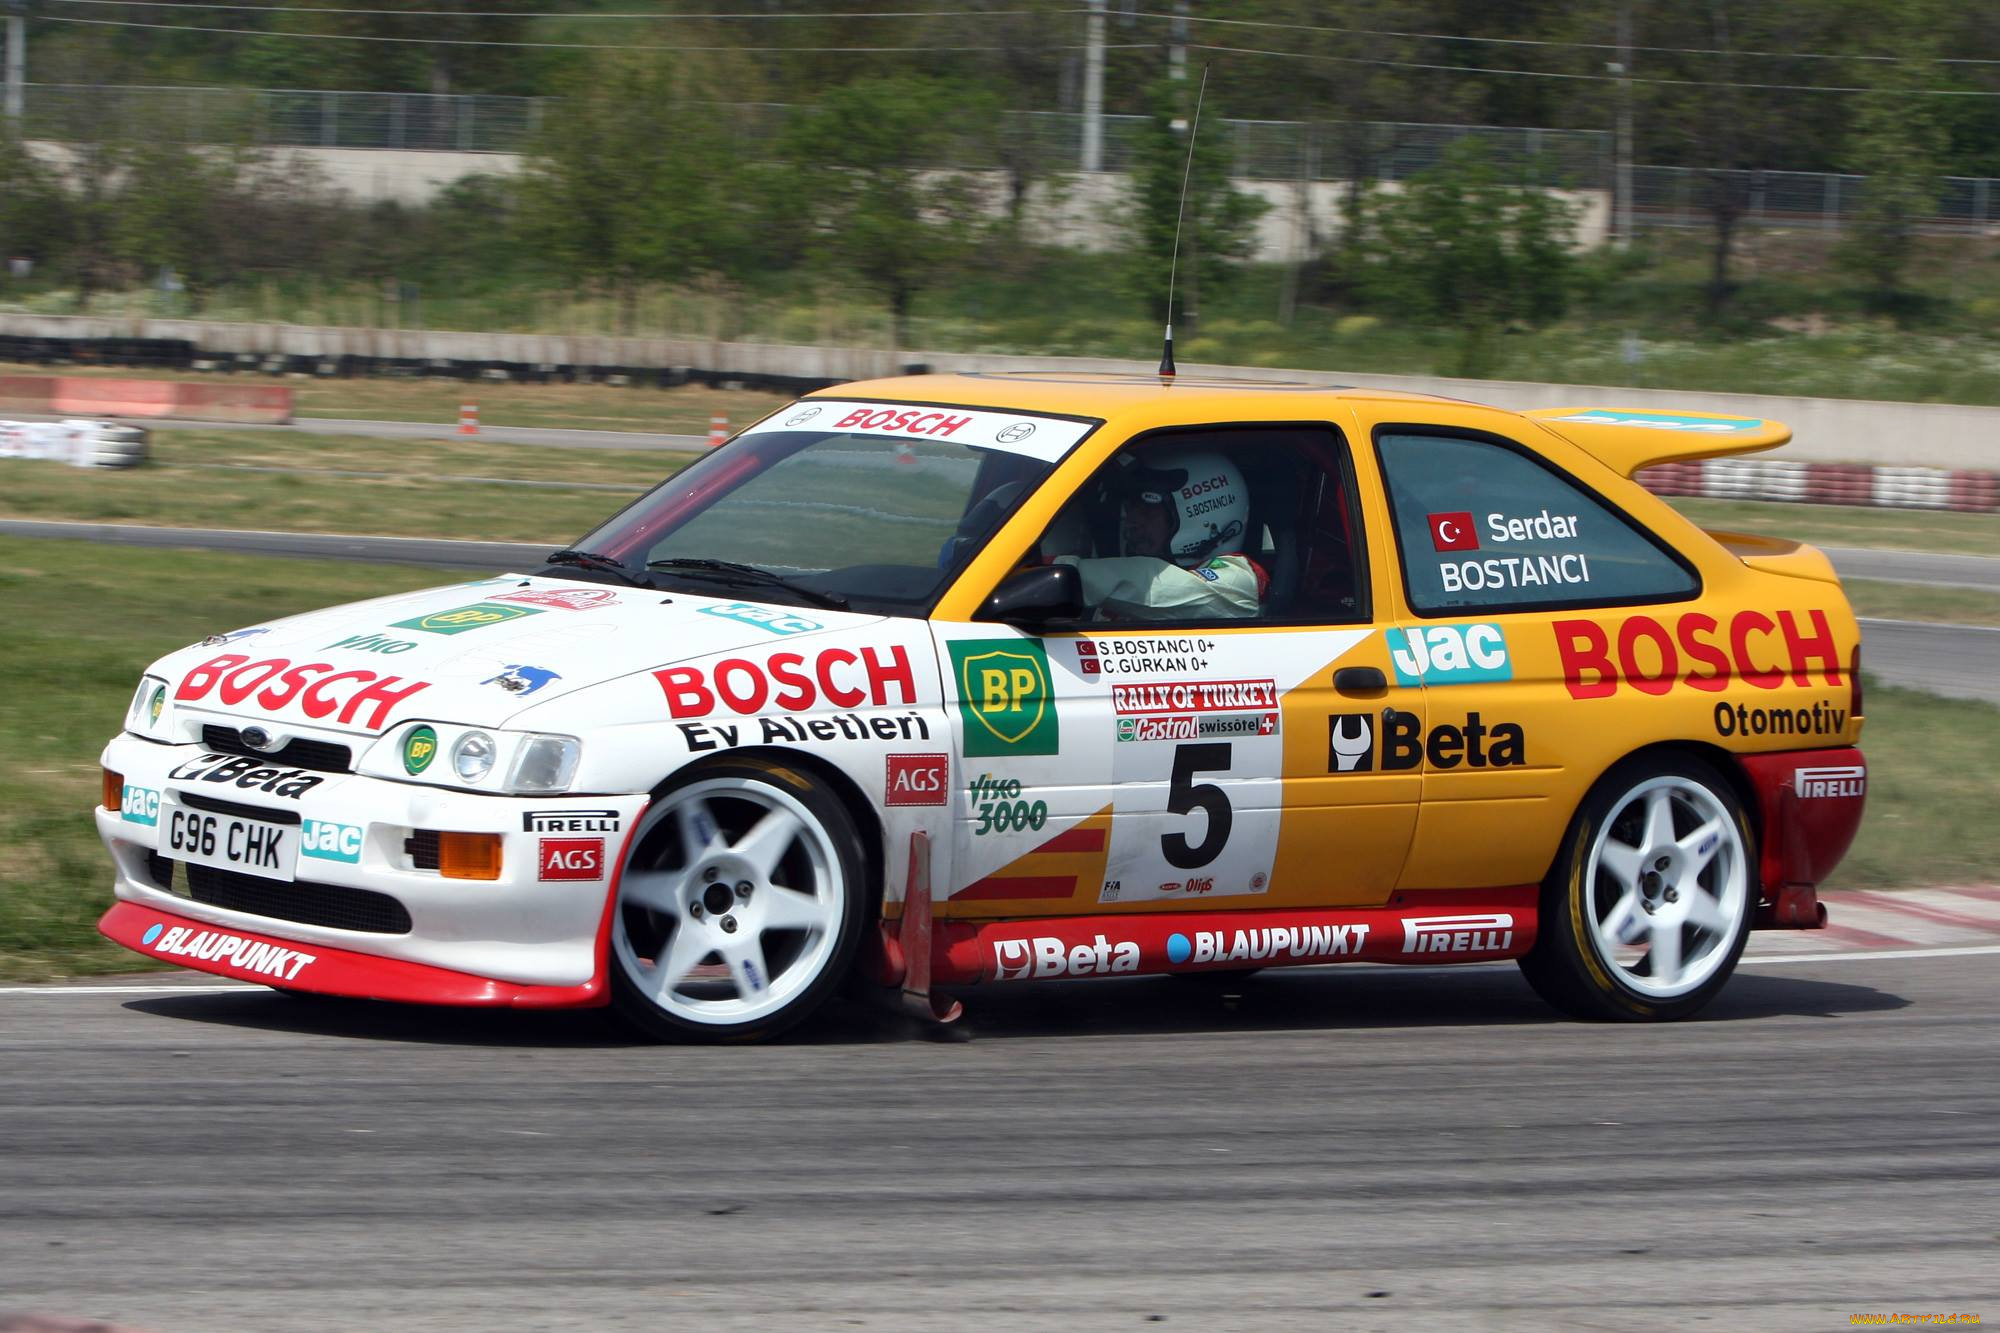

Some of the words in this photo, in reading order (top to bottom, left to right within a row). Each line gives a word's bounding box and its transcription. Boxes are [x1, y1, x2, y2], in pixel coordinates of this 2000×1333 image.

[832, 408, 973, 437] BOSCH
[1181, 474, 1229, 500] BOSCH
[1487, 510, 1578, 542] Serdar
[1439, 554, 1590, 592] BOSTANCI
[1099, 639, 1194, 656] S.BOSTANCI
[1103, 655, 1187, 674] C.GÜRKAN
[1551, 609, 1844, 700] BOSCH
[173, 654, 433, 731] BOSCH
[651, 645, 918, 719] BOSCH
[981, 668, 1036, 713] BP
[1113, 685, 1171, 711] RALLY
[1172, 684, 1196, 709] OF
[1199, 681, 1275, 709] TURKEY
[676, 722, 739, 752] Ev
[759, 711, 930, 744] Aletleri
[1135, 717, 1197, 741] Castrol
[1198, 717, 1260, 734] swissôtel
[1714, 700, 1846, 736] Otomotiv
[411, 742, 433, 758] BP
[1381, 710, 1527, 770] Beta
[201, 757, 324, 800] Beta
[894, 768, 940, 791] AGS
[1795, 766, 1866, 798] PIRELLI
[522, 810, 620, 832] PIRELLI
[975, 800, 1048, 836] 3000
[1161, 742, 1233, 870] 5
[170, 810, 217, 856] G96
[227, 821, 284, 869] CHK
[547, 850, 596, 869] AGS
[1193, 924, 1370, 963] BLAUPUNKT
[1401, 913, 1513, 953] PIRELLI
[155, 926, 317, 981] BLAUPUNKT
[1033, 933, 1141, 978] Beta
